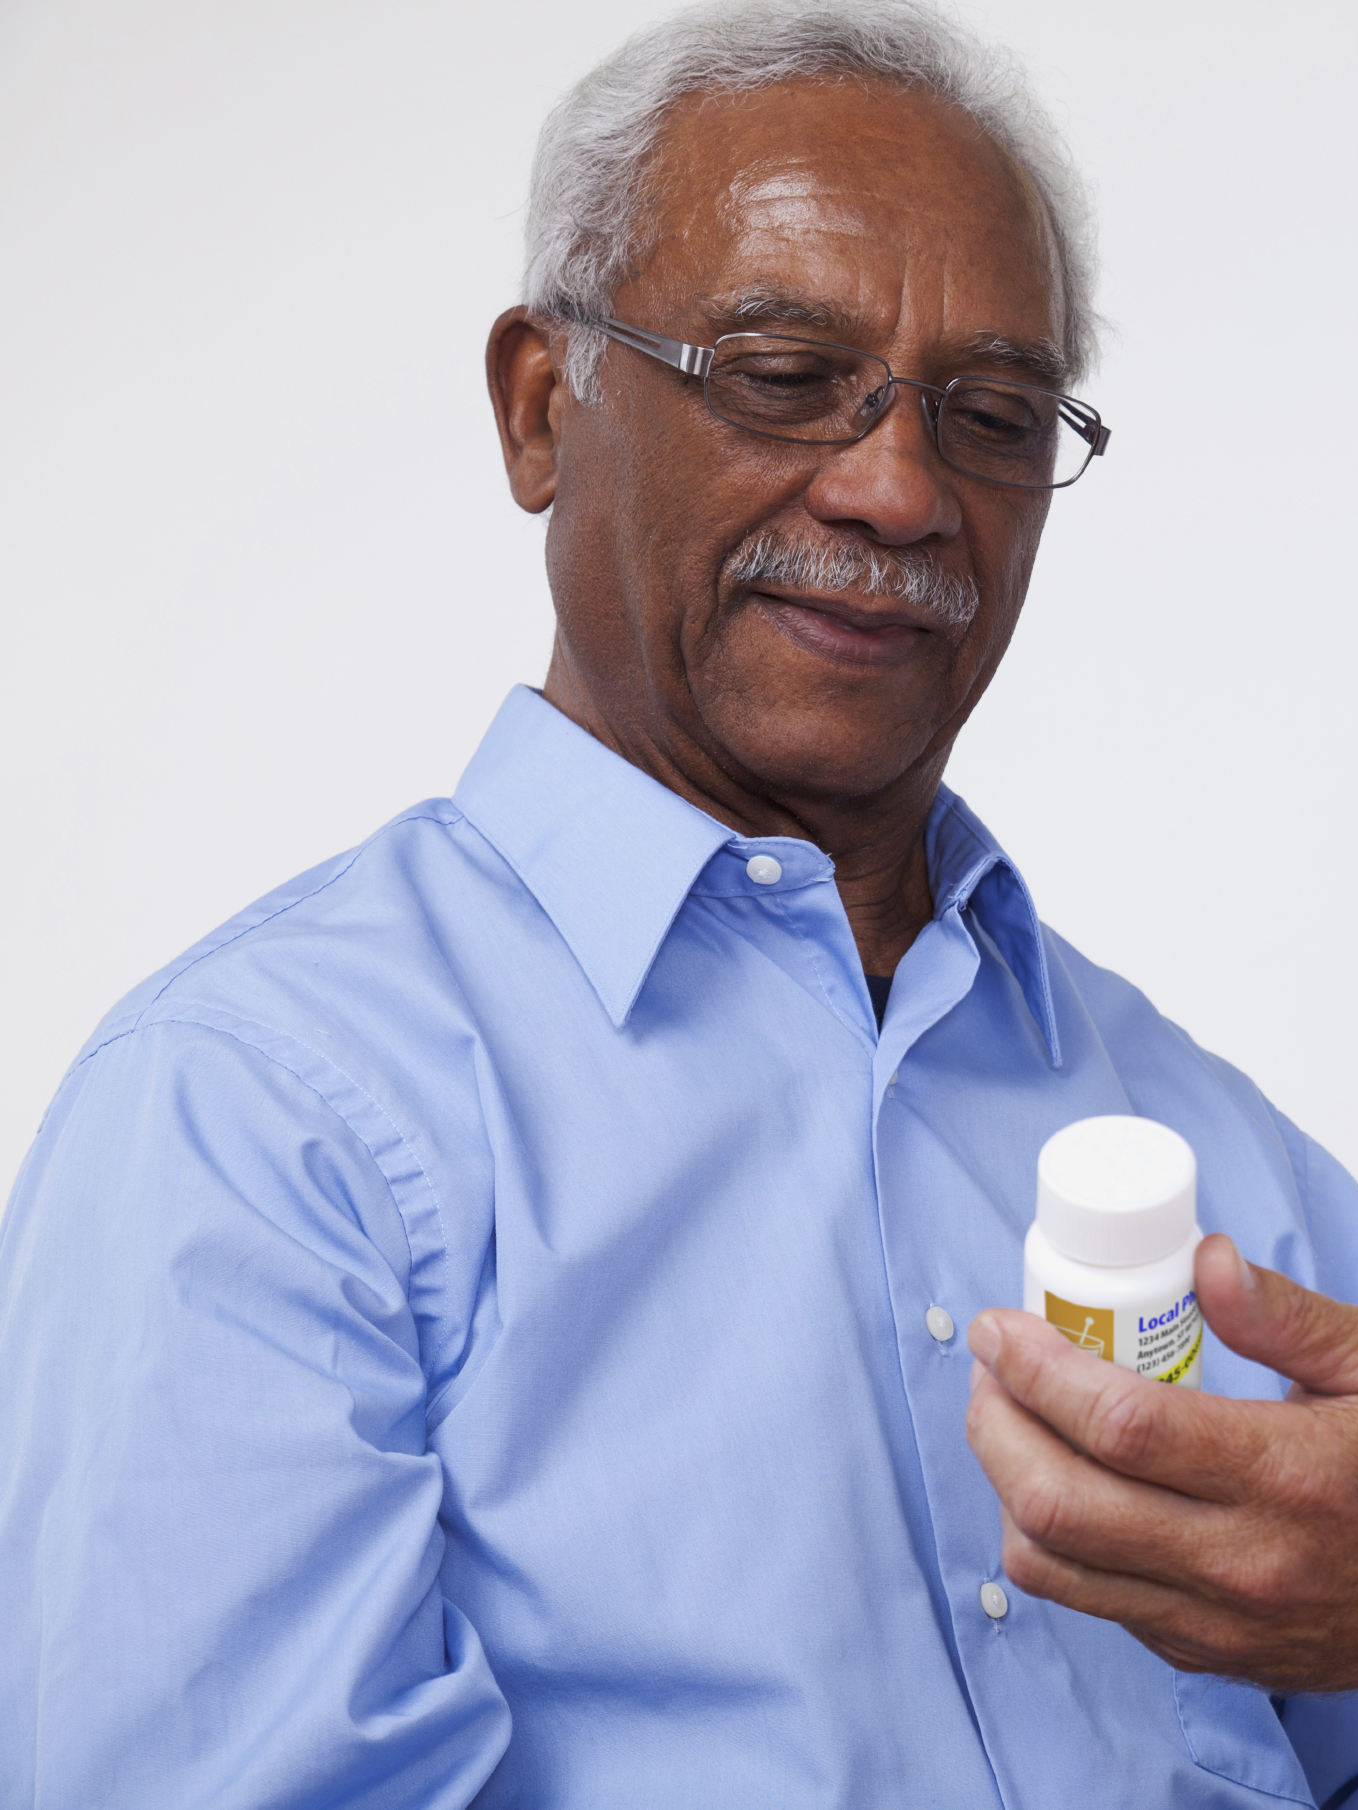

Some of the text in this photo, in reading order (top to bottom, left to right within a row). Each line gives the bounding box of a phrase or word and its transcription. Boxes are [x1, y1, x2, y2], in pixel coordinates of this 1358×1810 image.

[1139, 1302, 1179, 1333] Local
[1138, 1332, 1159, 1347] 1234
[1160, 1323, 1179, 1339] Main
[1136, 1357, 1160, 1375] (123)
